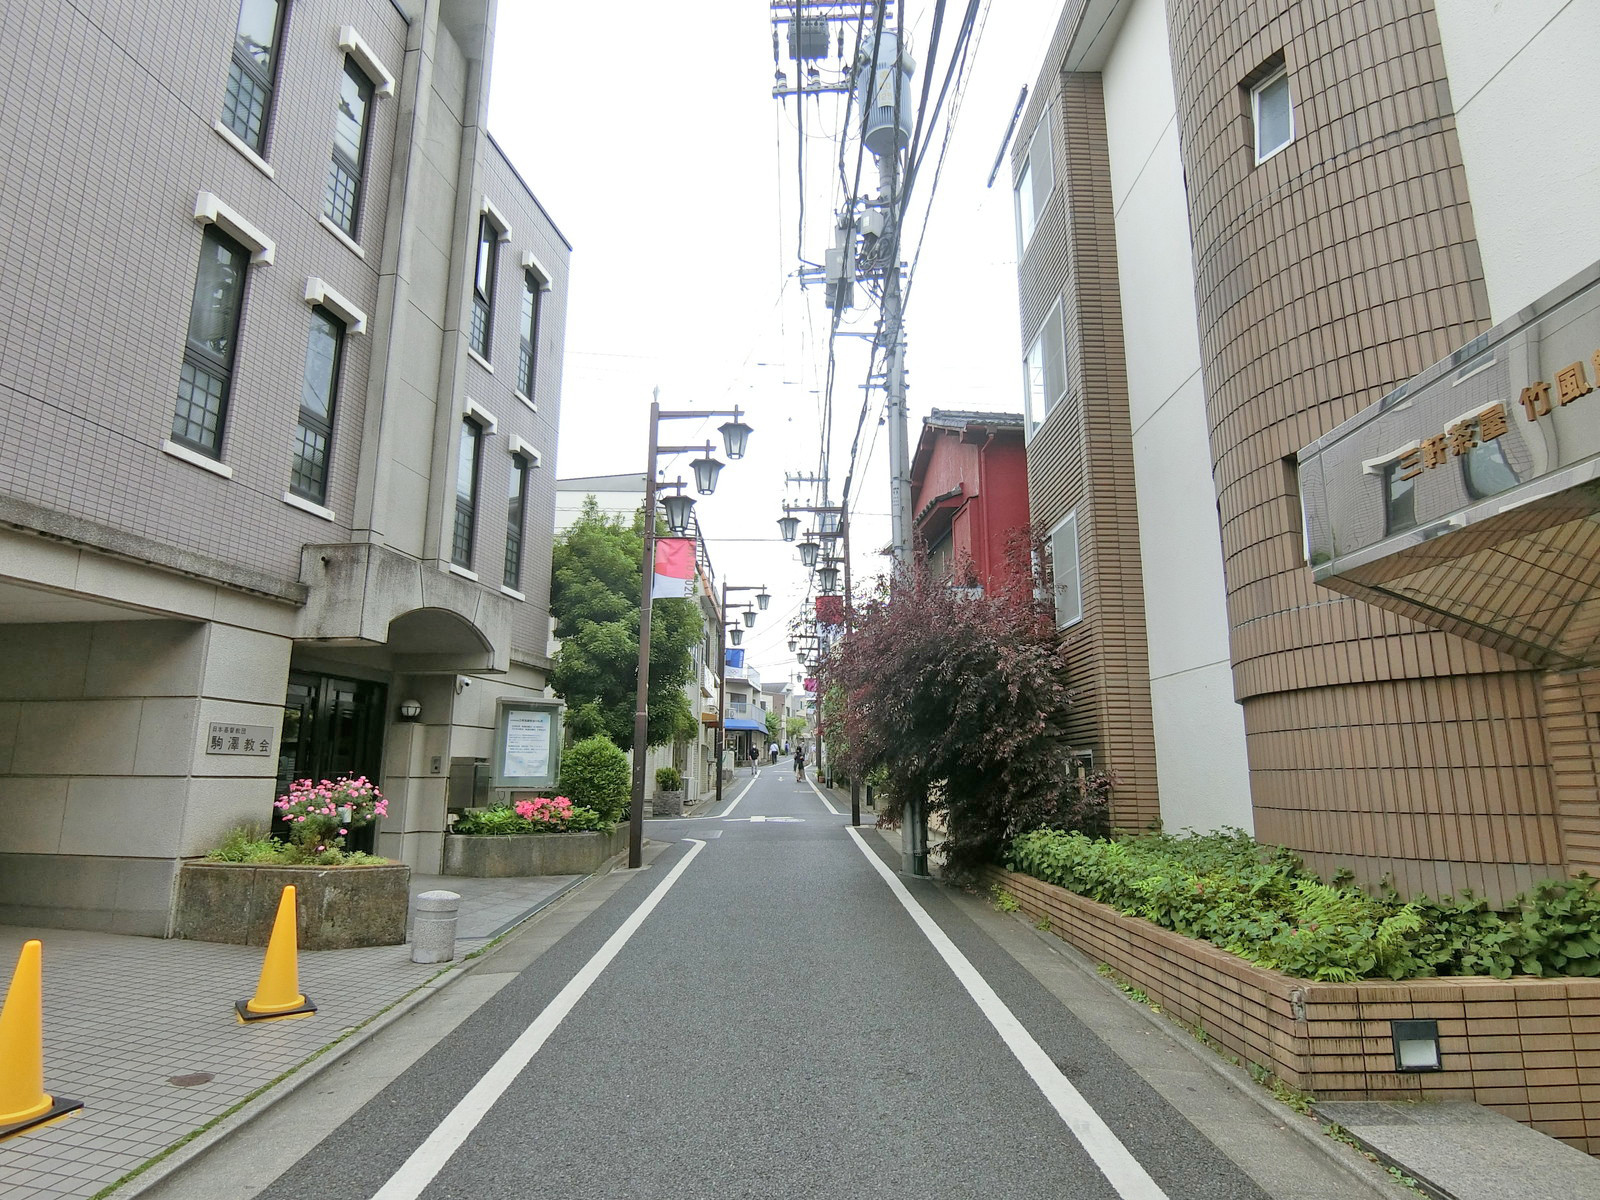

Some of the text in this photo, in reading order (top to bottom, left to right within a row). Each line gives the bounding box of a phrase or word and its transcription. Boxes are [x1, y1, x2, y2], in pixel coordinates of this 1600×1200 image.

[1399, 349, 1600, 481] 三軒茶屋 竹風
[211, 735, 269, 752] 駒澤教会
